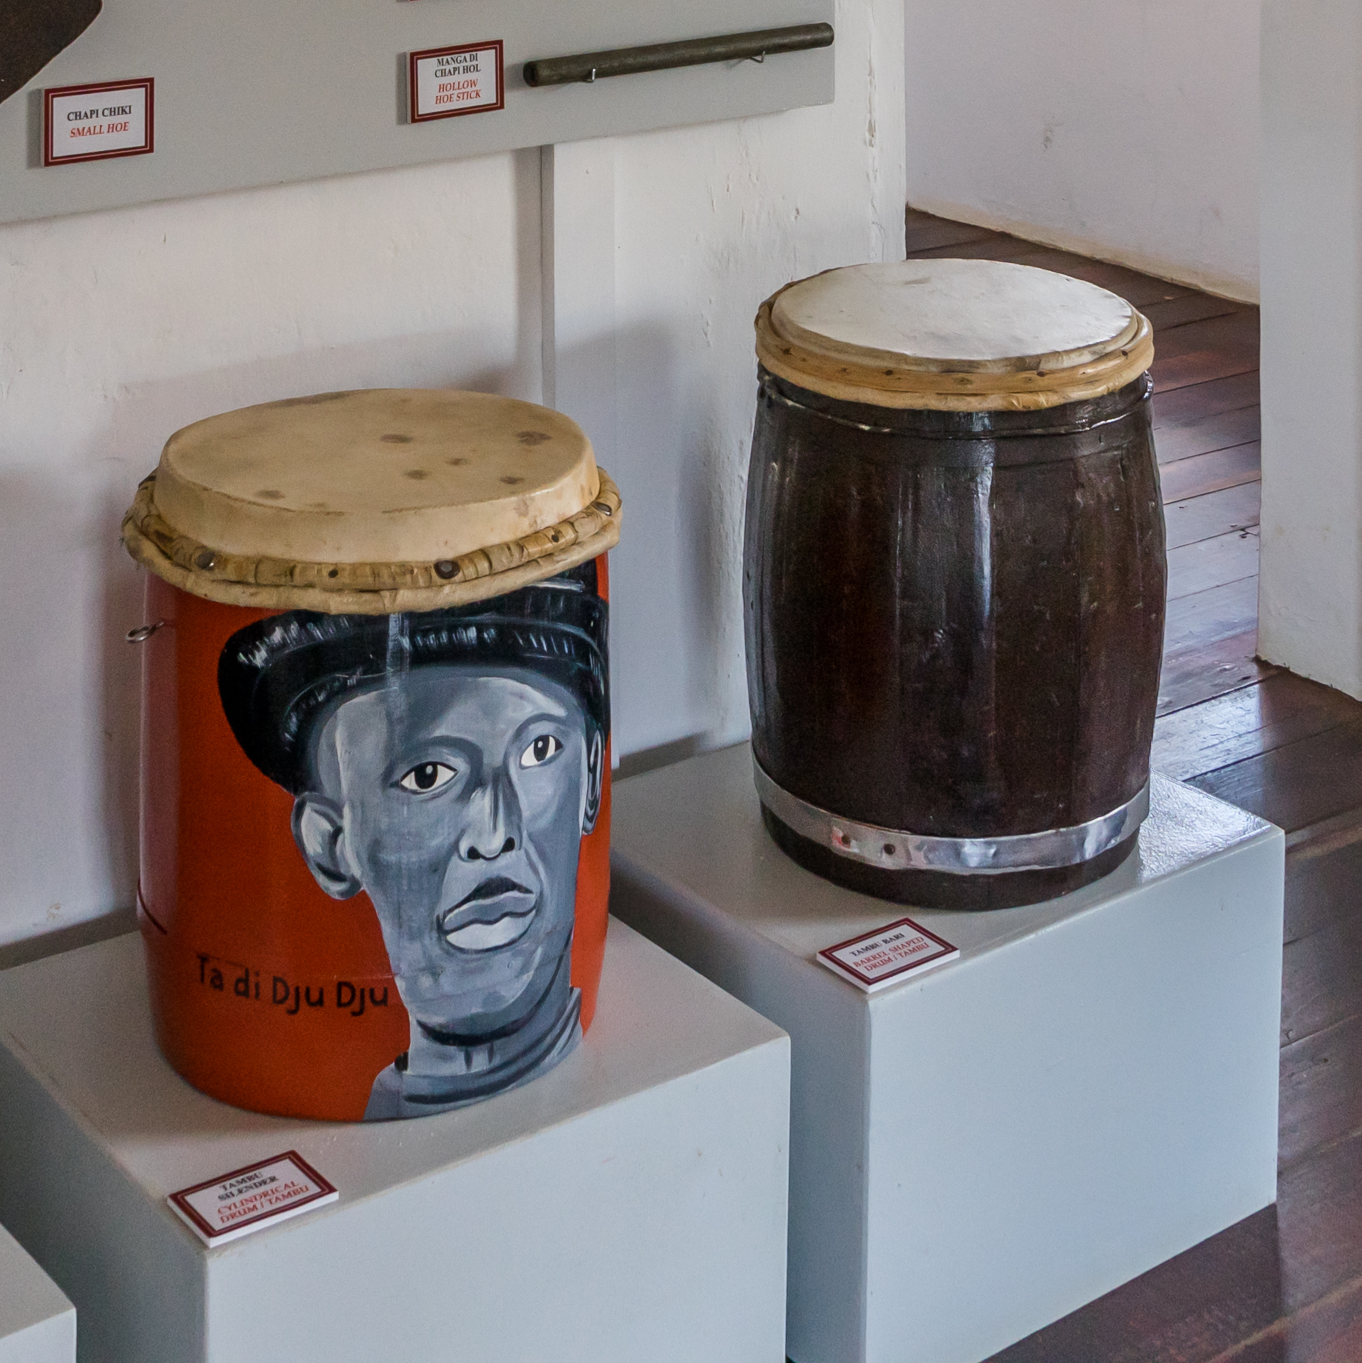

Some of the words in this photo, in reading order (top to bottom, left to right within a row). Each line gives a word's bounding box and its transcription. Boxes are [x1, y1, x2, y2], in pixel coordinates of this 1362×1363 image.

[437, 56, 467, 67] MANGA
[469, 53, 478, 62] DI
[435, 67, 460, 78] CHAPI
[463, 64, 481, 74] HOL
[438, 79, 478, 93] HOLLOW
[435, 93, 454, 104] HOE
[456, 90, 481, 101] STICK
[67, 109, 99, 121] CHAPI
[102, 105, 132, 117] CHIKI
[70, 124, 104, 138] SMALL
[107, 122, 129, 134] HOE
[849, 942, 883, 956] TAMBU
[882, 933, 905, 944] BARI
[853, 951, 889, 967] BARREL
[888, 936, 924, 952] SHAPED
[864, 957, 893, 972] DRUM
[898, 942, 930, 958] TAMBU
[197, 954, 224, 991] Ta
[234, 967, 260, 1000] di
[272, 976, 325, 1015] Dju
[336, 981, 388, 1016] Dju
[220, 1171, 263, 1191] TAMBU
[218, 1180, 299, 1214] CYLINDRICAL
[220, 1204, 258, 1223] DRUM
[266, 1185, 309, 1205] TAMBU
